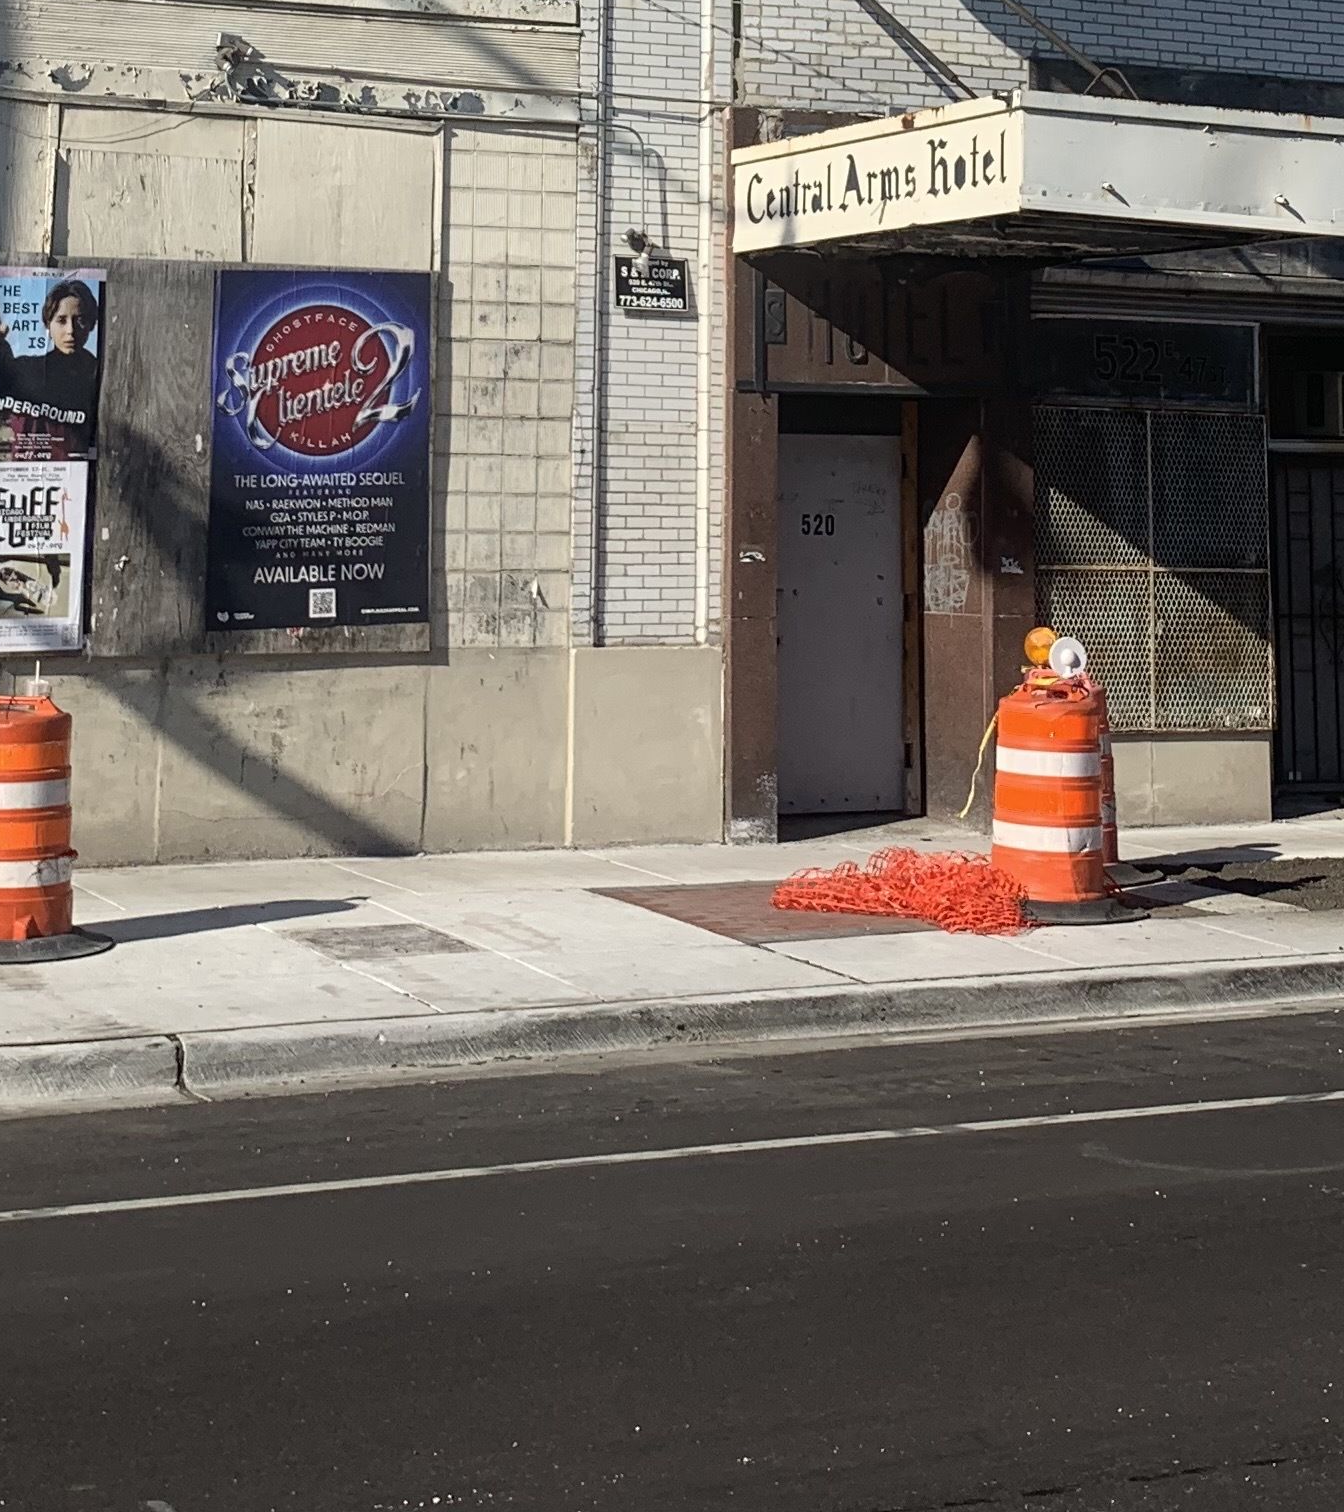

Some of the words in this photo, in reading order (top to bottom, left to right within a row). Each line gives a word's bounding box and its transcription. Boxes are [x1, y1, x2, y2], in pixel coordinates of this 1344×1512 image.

[747, 162, 832, 224] Central
[839, 154, 917, 212] Arms
[927, 129, 1007, 197] Hotel
[621, 266, 628, 277] S
[652, 269, 681, 280] CORP.
[3, 303, 39, 314] BEST
[619, 295, 684, 309] 773-624-6500
[12, 320, 39, 331] ART
[28, 337, 46, 349] IS
[1093, 334, 1162, 382] 522
[217, 340, 343, 416] Supreme
[350, 321, 421, 432] 2
[247, 369, 365, 449] Clientele
[289, 433, 351, 448] KILLAH
[15, 451, 51, 459] cuff.org
[234, 475, 257, 488] THE
[261, 473, 356, 487] LONG-AWAITED
[359, 472, 405, 485] SEQUEL
[246, 500, 264, 509] NAS
[272, 499, 321, 509] RAEKWON
[328, 498, 370, 508] METHOD
[371, 497, 393, 507] MAN
[270, 513, 290, 523] GZA
[298, 512, 328, 522] STYLES
[330, 511, 336, 521] P
[243, 526, 286, 537] CONWAY
[287, 525, 304, 535] THE
[306, 524, 348, 535] MACHINE
[356, 523, 395, 533] REDMAN
[801, 513, 835, 536] 520
[256, 539, 277, 549] YAPP
[279, 539, 299, 548] CITY
[301, 538, 325, 548] TEAM
[333, 537, 344, 547] TY
[345, 536, 383, 546] BOOGIE
[337, 549, 363, 557] MORE
[254, 565, 336, 584] AVAILABLE
[341, 563, 385, 581] NOW
